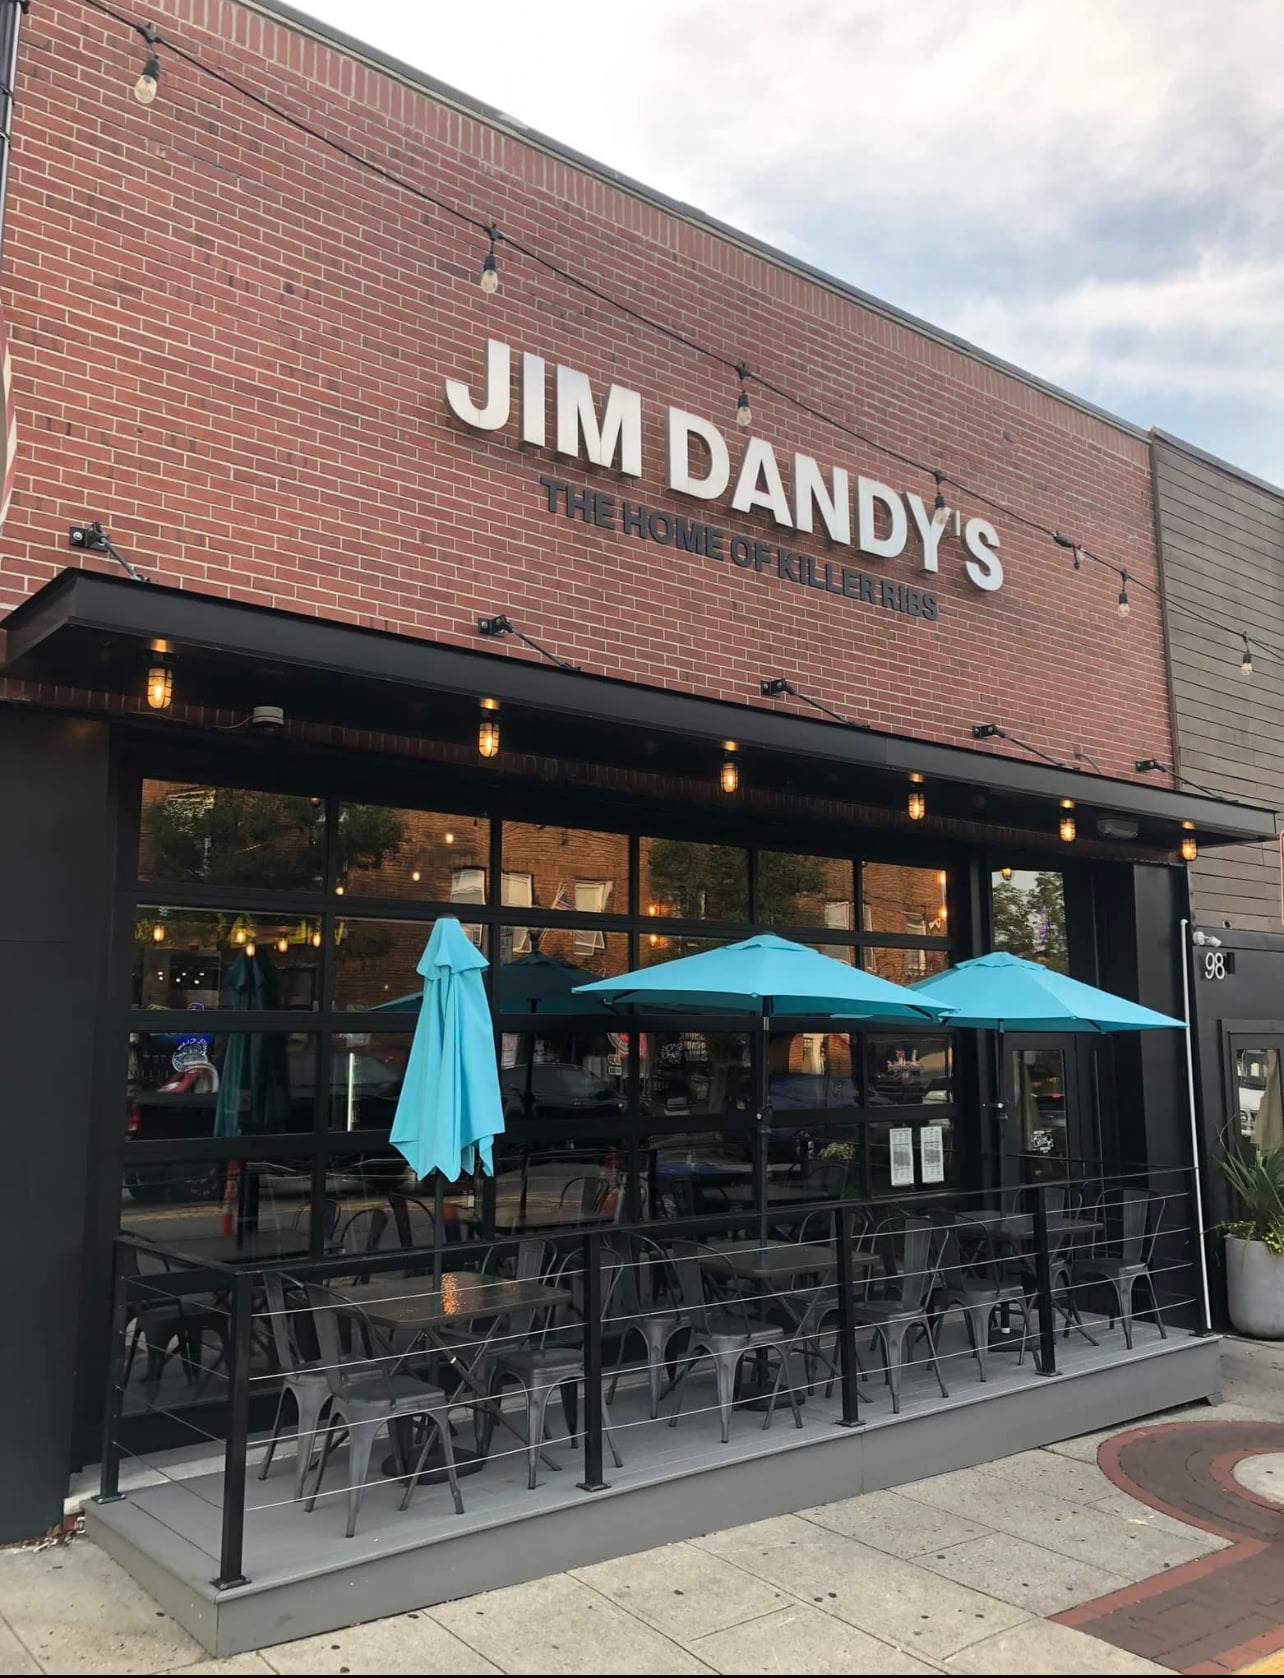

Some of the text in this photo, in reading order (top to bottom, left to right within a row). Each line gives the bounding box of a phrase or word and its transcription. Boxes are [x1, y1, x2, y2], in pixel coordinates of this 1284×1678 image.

[445, 338, 1004, 592] JIM DANDY'S
[540, 475, 939, 621] THE HOME OF KILLER RIBS
[1205, 952, 1225, 979] 98
